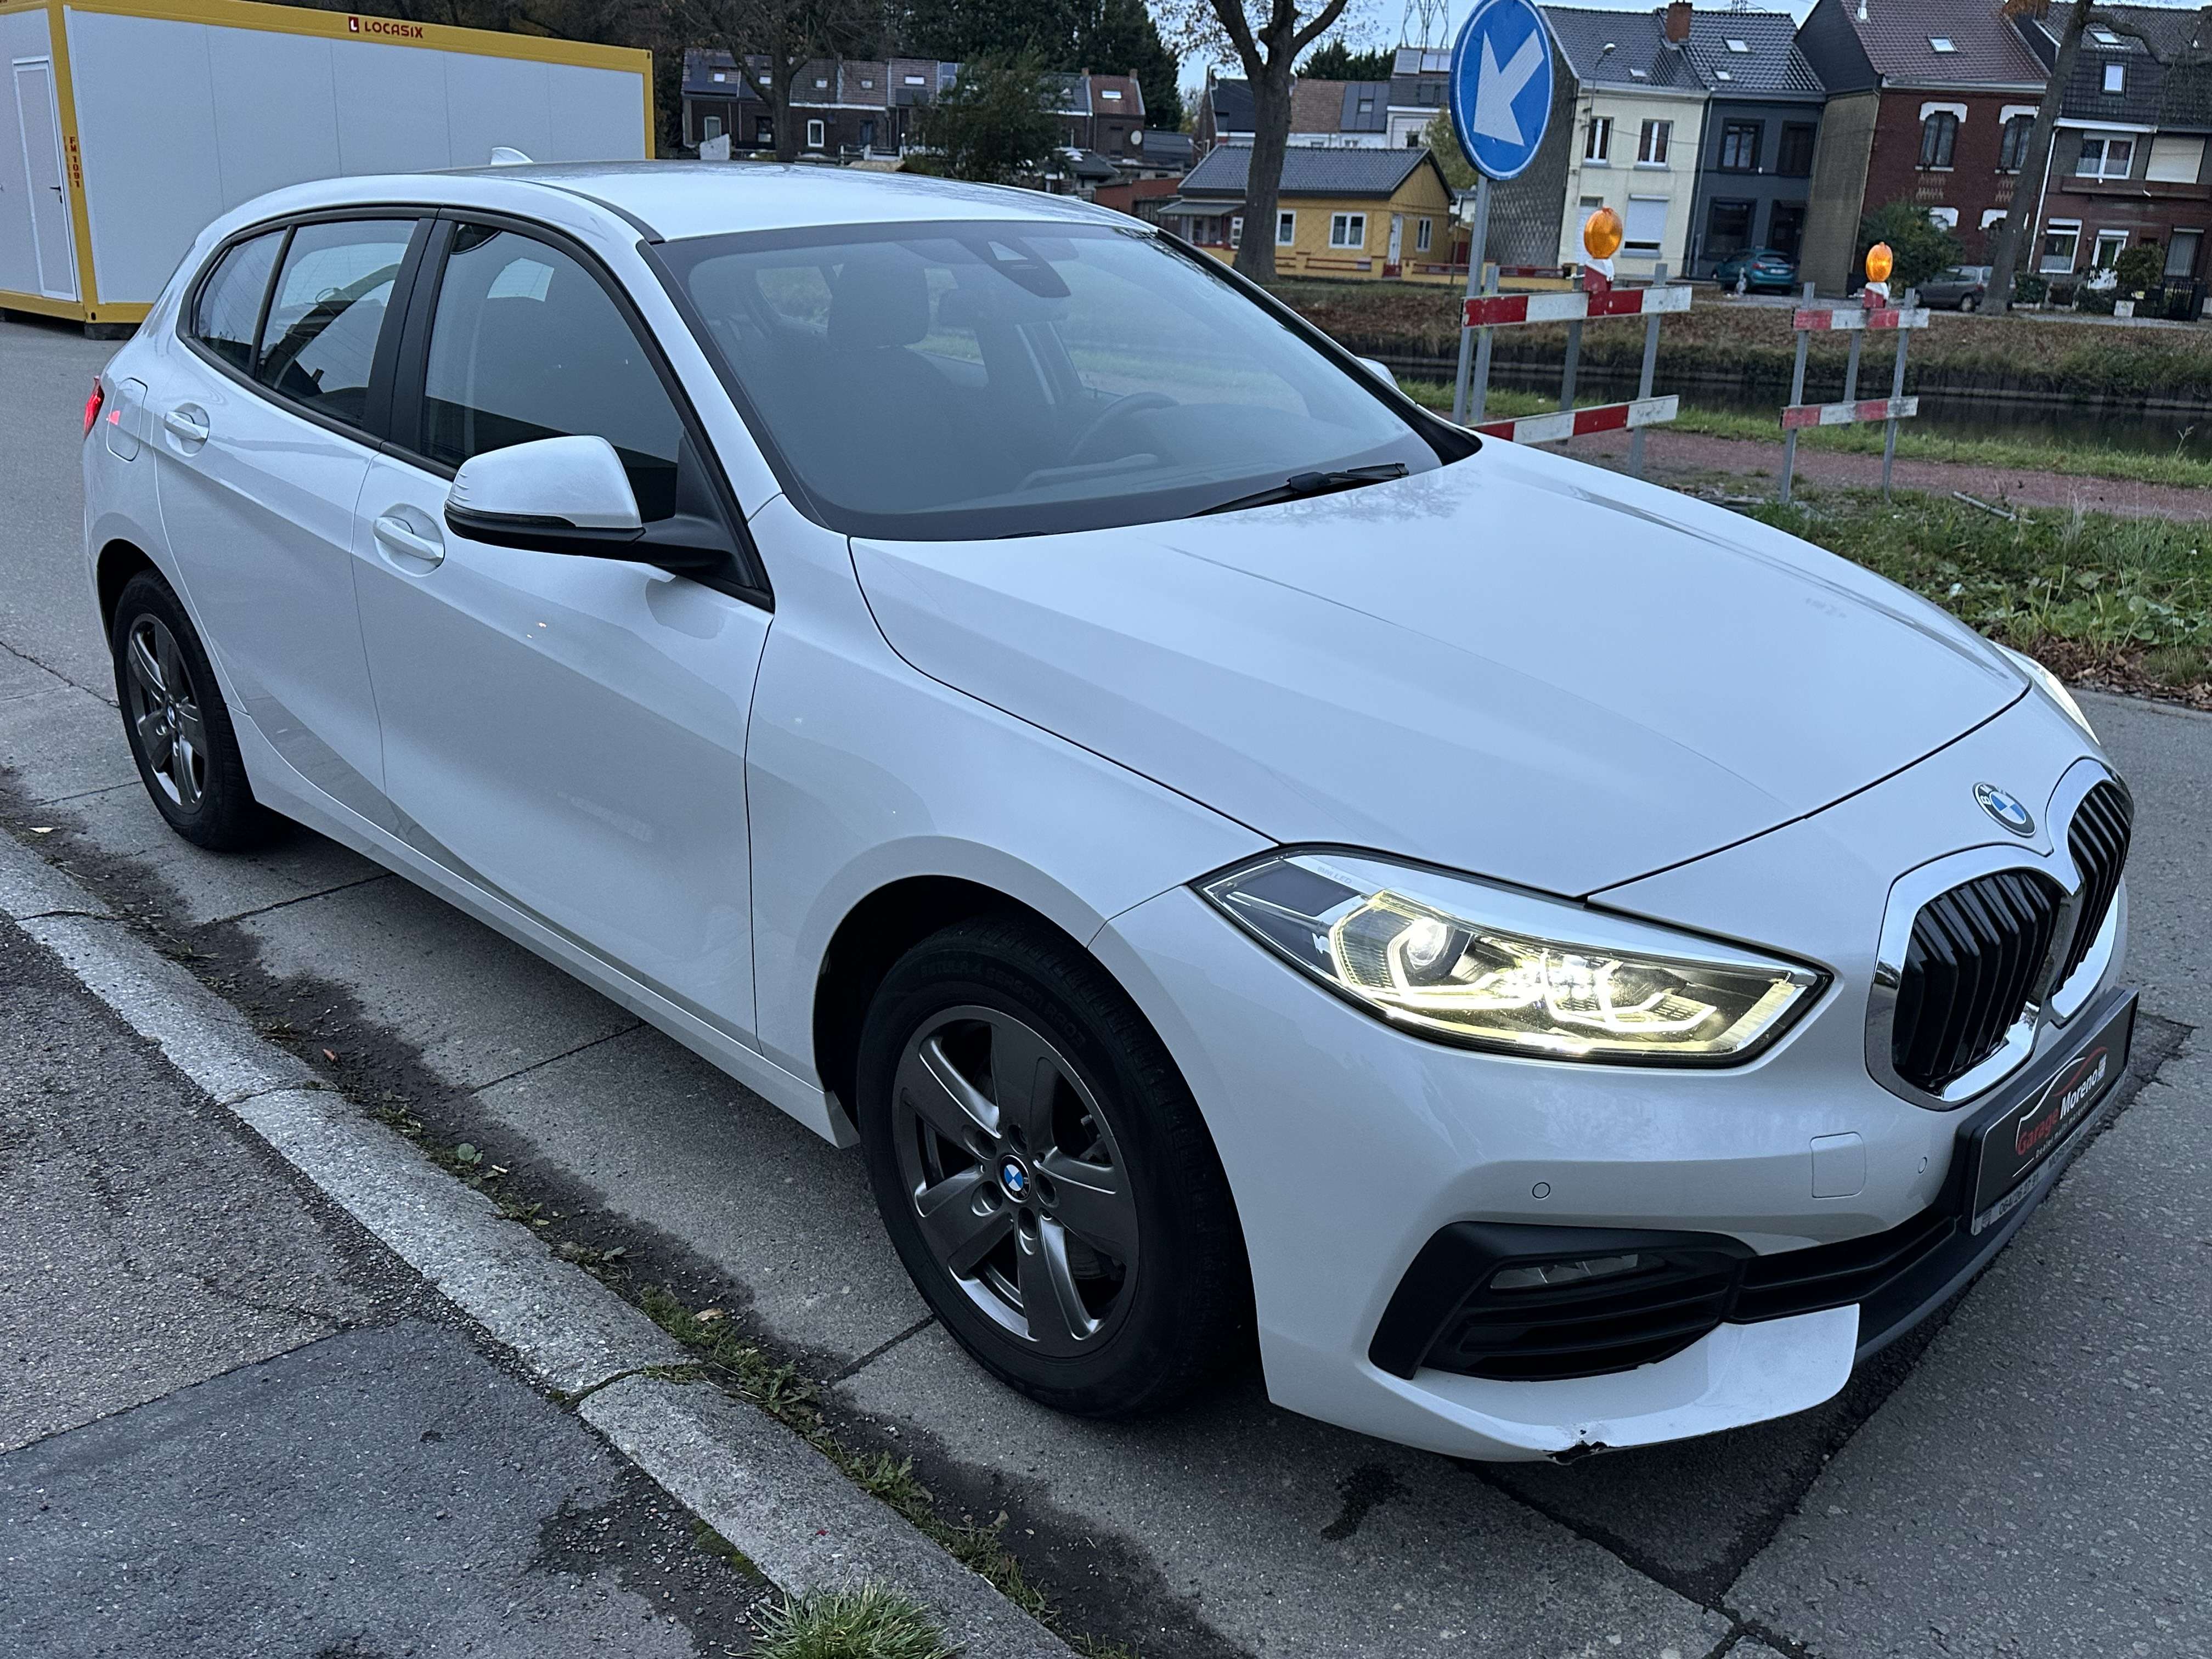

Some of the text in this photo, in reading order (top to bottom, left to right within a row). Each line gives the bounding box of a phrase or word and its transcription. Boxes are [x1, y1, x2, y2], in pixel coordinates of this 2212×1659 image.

[365, 21, 423, 38] LOCASIX
[70, 137, 77, 152] FM
[1334, 873, 1352, 883] LED
[2018, 1108, 2059, 1155] Garage
[2060, 1069, 2097, 1120] Moreno
